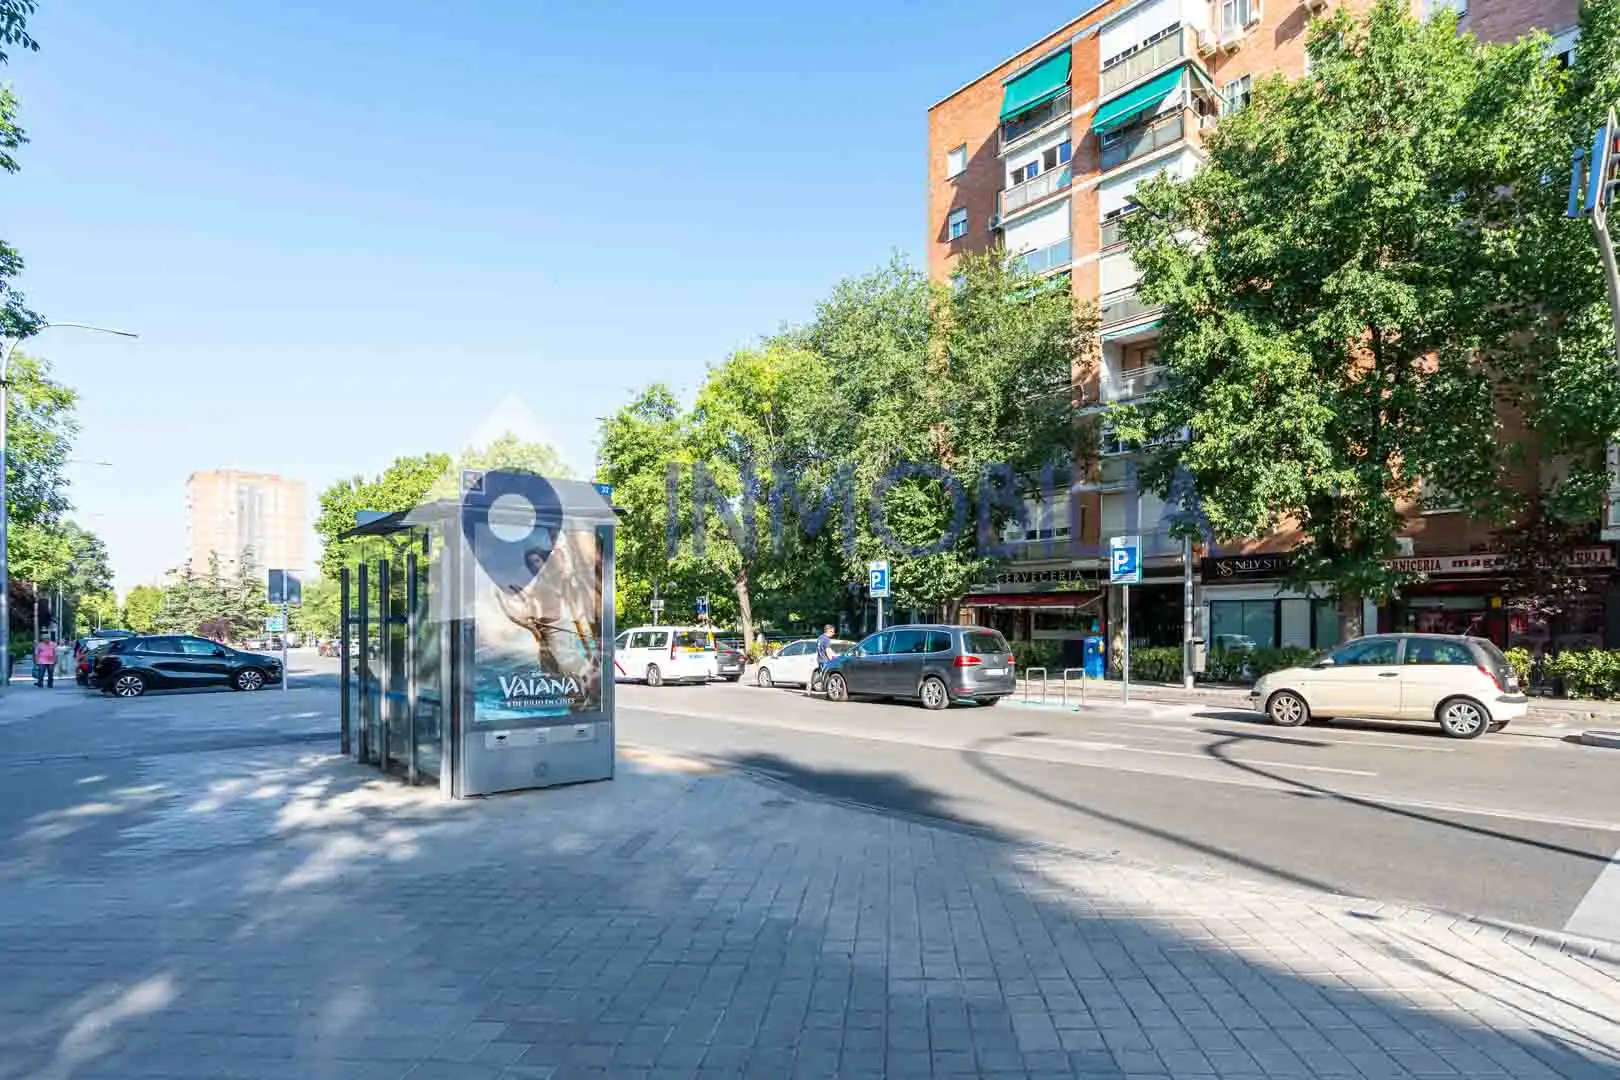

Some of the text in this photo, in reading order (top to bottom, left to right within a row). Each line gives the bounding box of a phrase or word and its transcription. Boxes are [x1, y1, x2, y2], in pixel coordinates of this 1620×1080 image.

[1114, 550, 1129, 572] P
[1235, 559, 1261, 570] NELY
[872, 571, 882, 588] P
[498, 675, 579, 699] VAIANA
[555, 697, 576, 705] CINES
